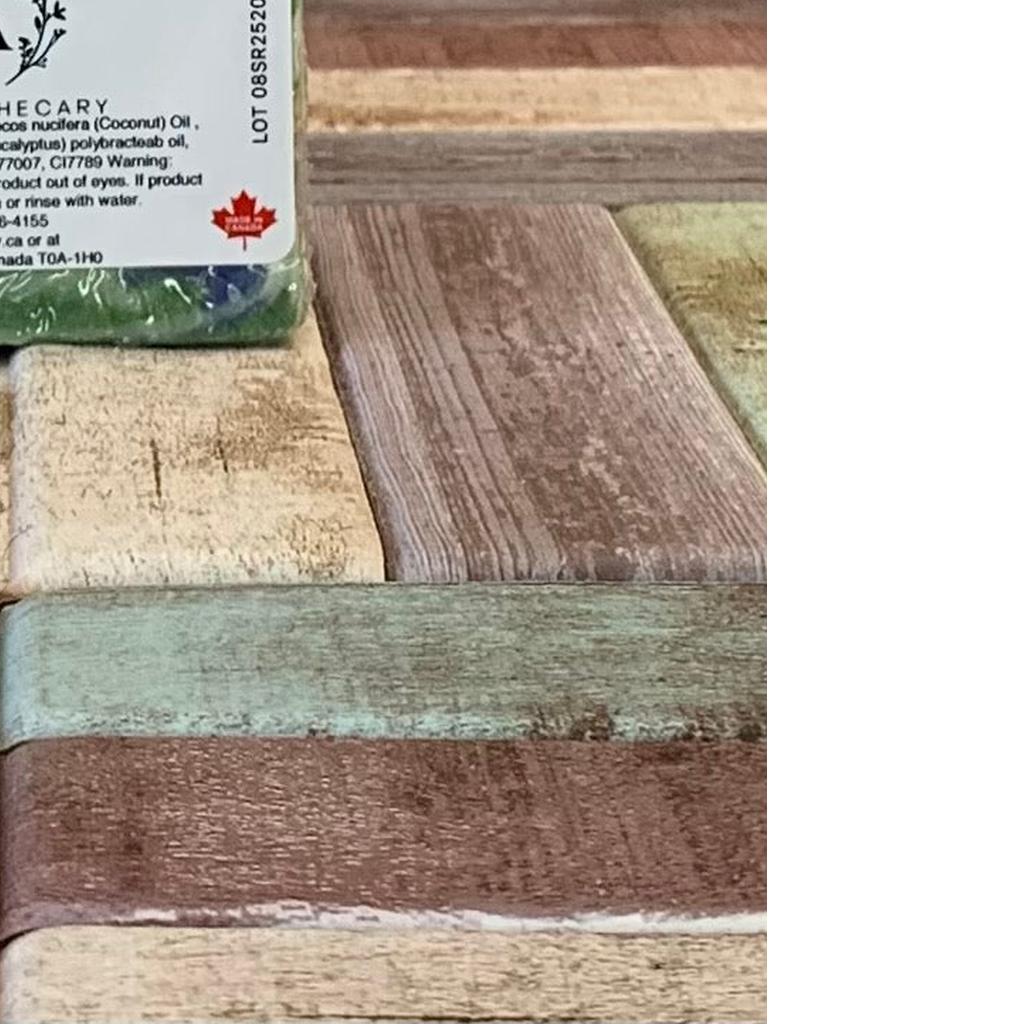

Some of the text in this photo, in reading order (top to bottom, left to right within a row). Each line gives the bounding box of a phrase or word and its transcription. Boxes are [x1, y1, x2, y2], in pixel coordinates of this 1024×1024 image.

[31, 117, 90, 132] nucifera
[94, 115, 166, 133] (Coconut)
[251, 105, 269, 144] LOT
[168, 134, 189, 150] oil,
[46, 176, 69, 189] out
[73, 175, 87, 188] of
[135, 173, 144, 187] If
[148, 172, 203, 189] product
[5, 197, 21, 209] or
[25, 194, 61, 209] rinse
[65, 193, 94, 208] with
[27, 235, 42, 247] or
[46, 233, 60, 246] at
